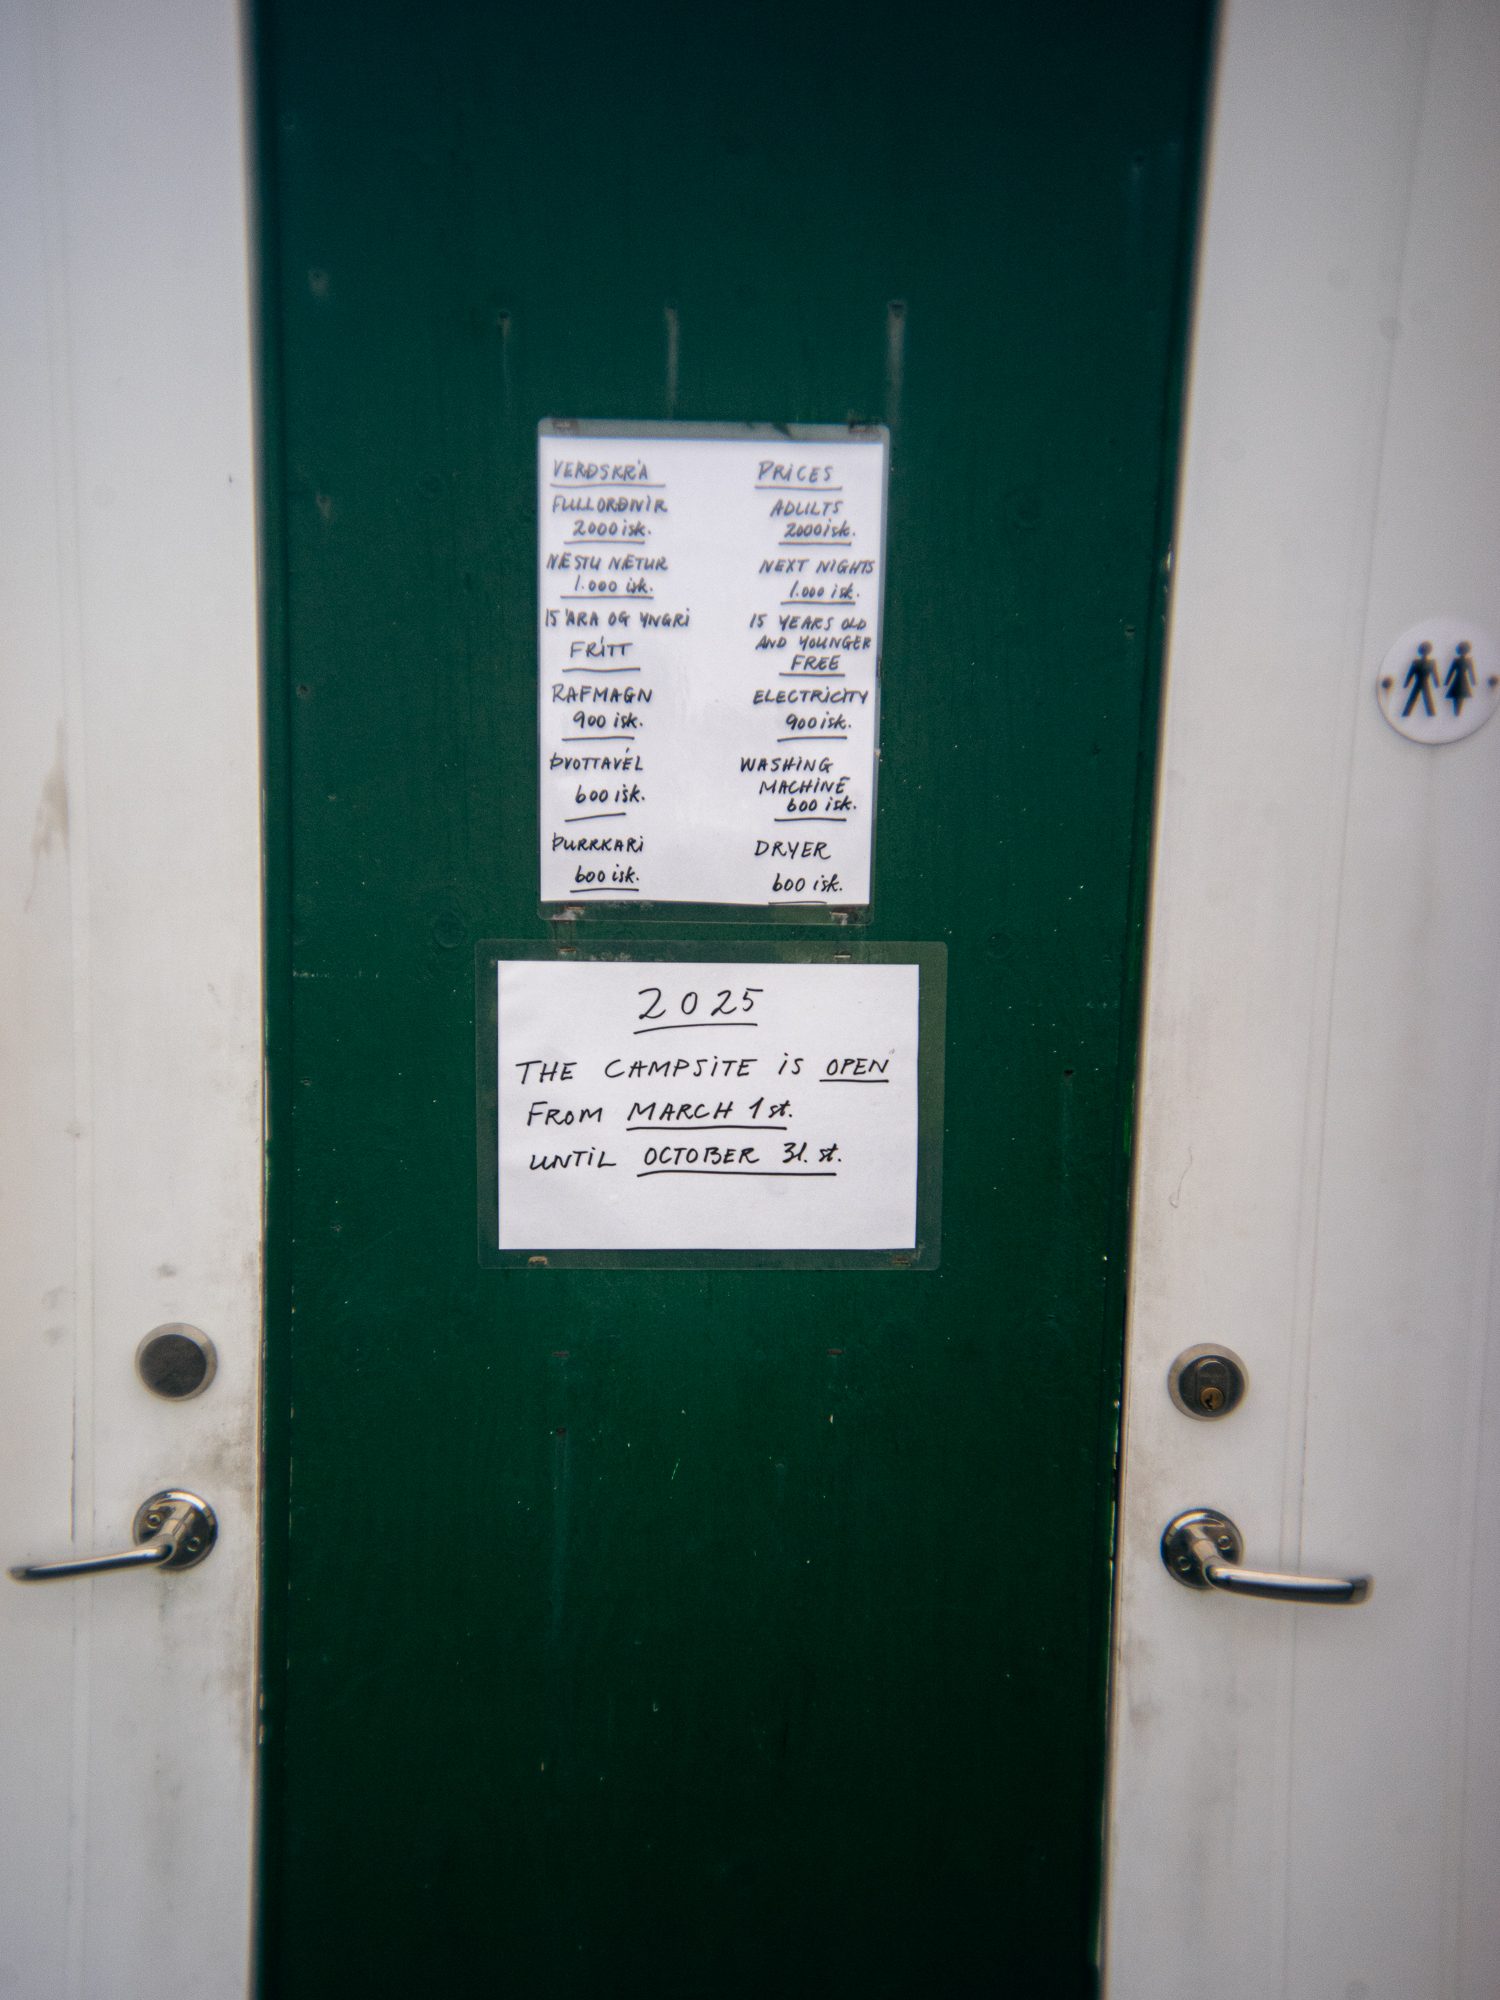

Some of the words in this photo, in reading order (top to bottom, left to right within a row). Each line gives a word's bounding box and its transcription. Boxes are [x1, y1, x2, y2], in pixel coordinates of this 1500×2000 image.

[769, 499, 844, 517] ADULTS
[758, 558, 810, 574] NEXT
[815, 559, 876, 575] NIGHTS
[574, 574, 618, 592] 1.000
[789, 580, 825, 598] 1.000
[545, 608, 560, 627] 15
[607, 610, 630, 628] OG
[750, 613, 767, 628] 15
[779, 614, 834, 631] YEARS
[841, 617, 867, 631] OLD
[755, 634, 787, 650] AND
[799, 635, 872, 651] YOUNGER
[790, 653, 841, 672] FREE
[551, 683, 653, 704] RAFMAGN
[572, 710, 606, 729] 900
[613, 712, 644, 729] isk.
[785, 713, 818, 730] 900
[575, 784, 608, 804] 600
[786, 798, 818, 812] 600
[754, 840, 832, 860] DRYER
[575, 865, 605, 884] 600
[772, 872, 806, 892] 600
[637, 986, 764, 1021] 2025
[515, 1059, 578, 1085] THE
[825, 1057, 890, 1076] OPEN
[526, 1101, 603, 1127] FROM
[626, 1101, 734, 1122] MARCH
[643, 1146, 760, 1165] OCTOBER
